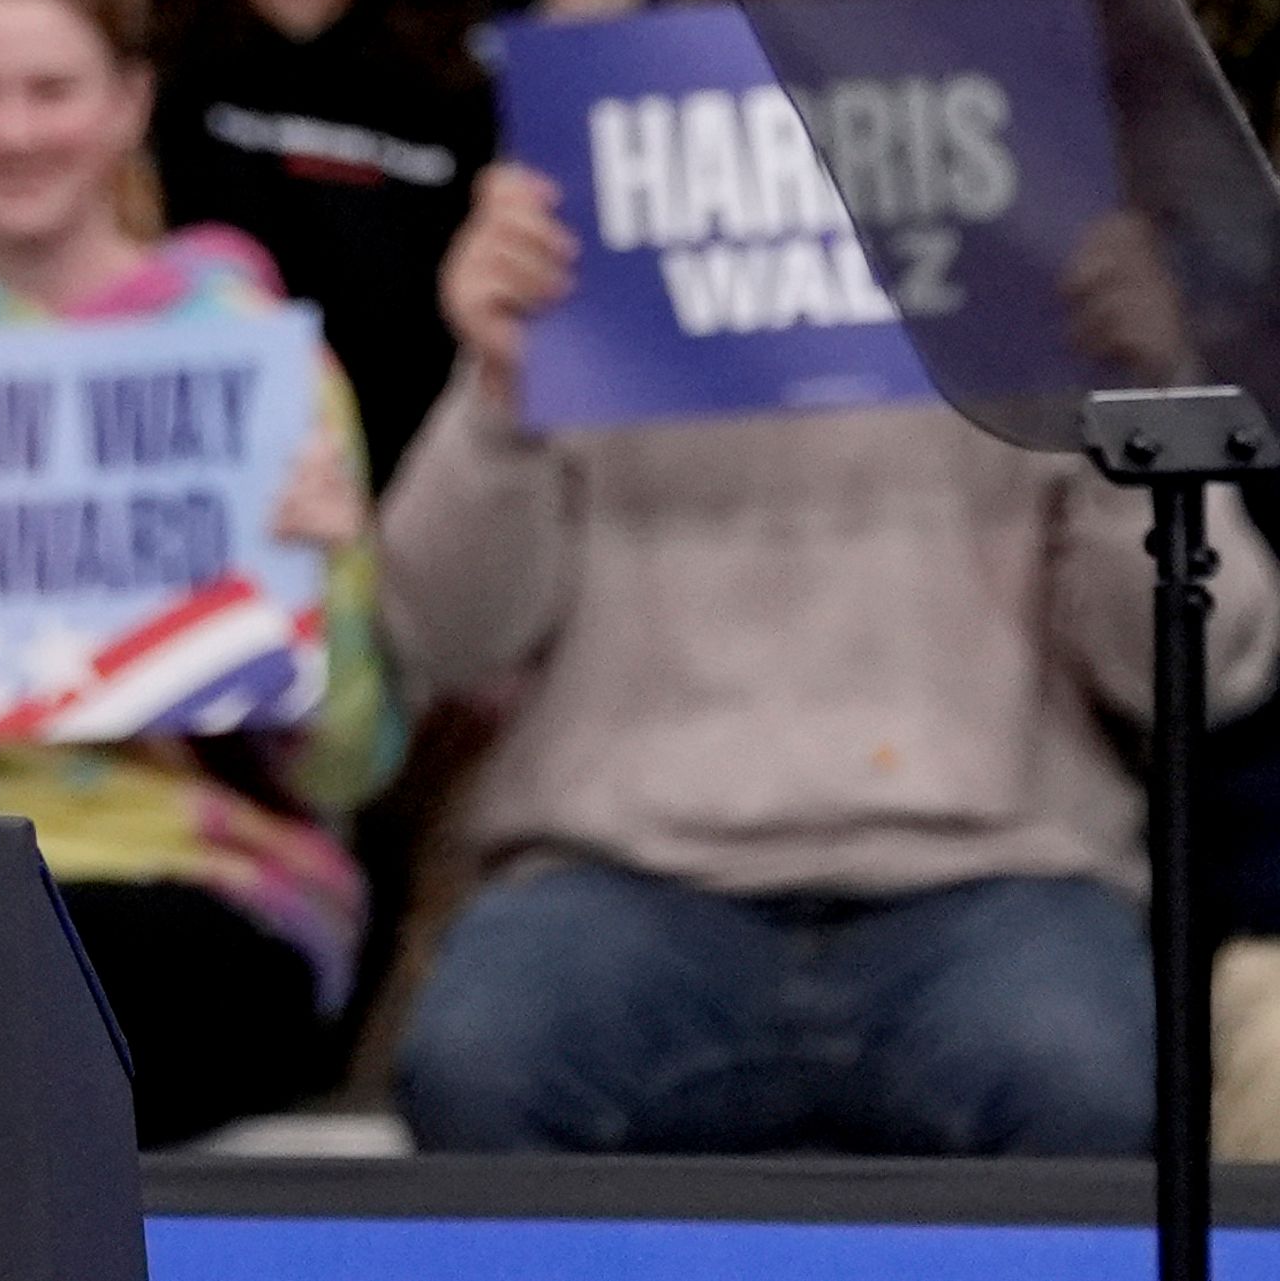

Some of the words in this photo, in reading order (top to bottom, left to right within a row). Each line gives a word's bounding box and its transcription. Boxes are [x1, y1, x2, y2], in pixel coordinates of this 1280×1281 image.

[588, 75, 1020, 253] HARRIS
[658, 225, 967, 337] WALZ
[78, 360, 260, 470] WAY
